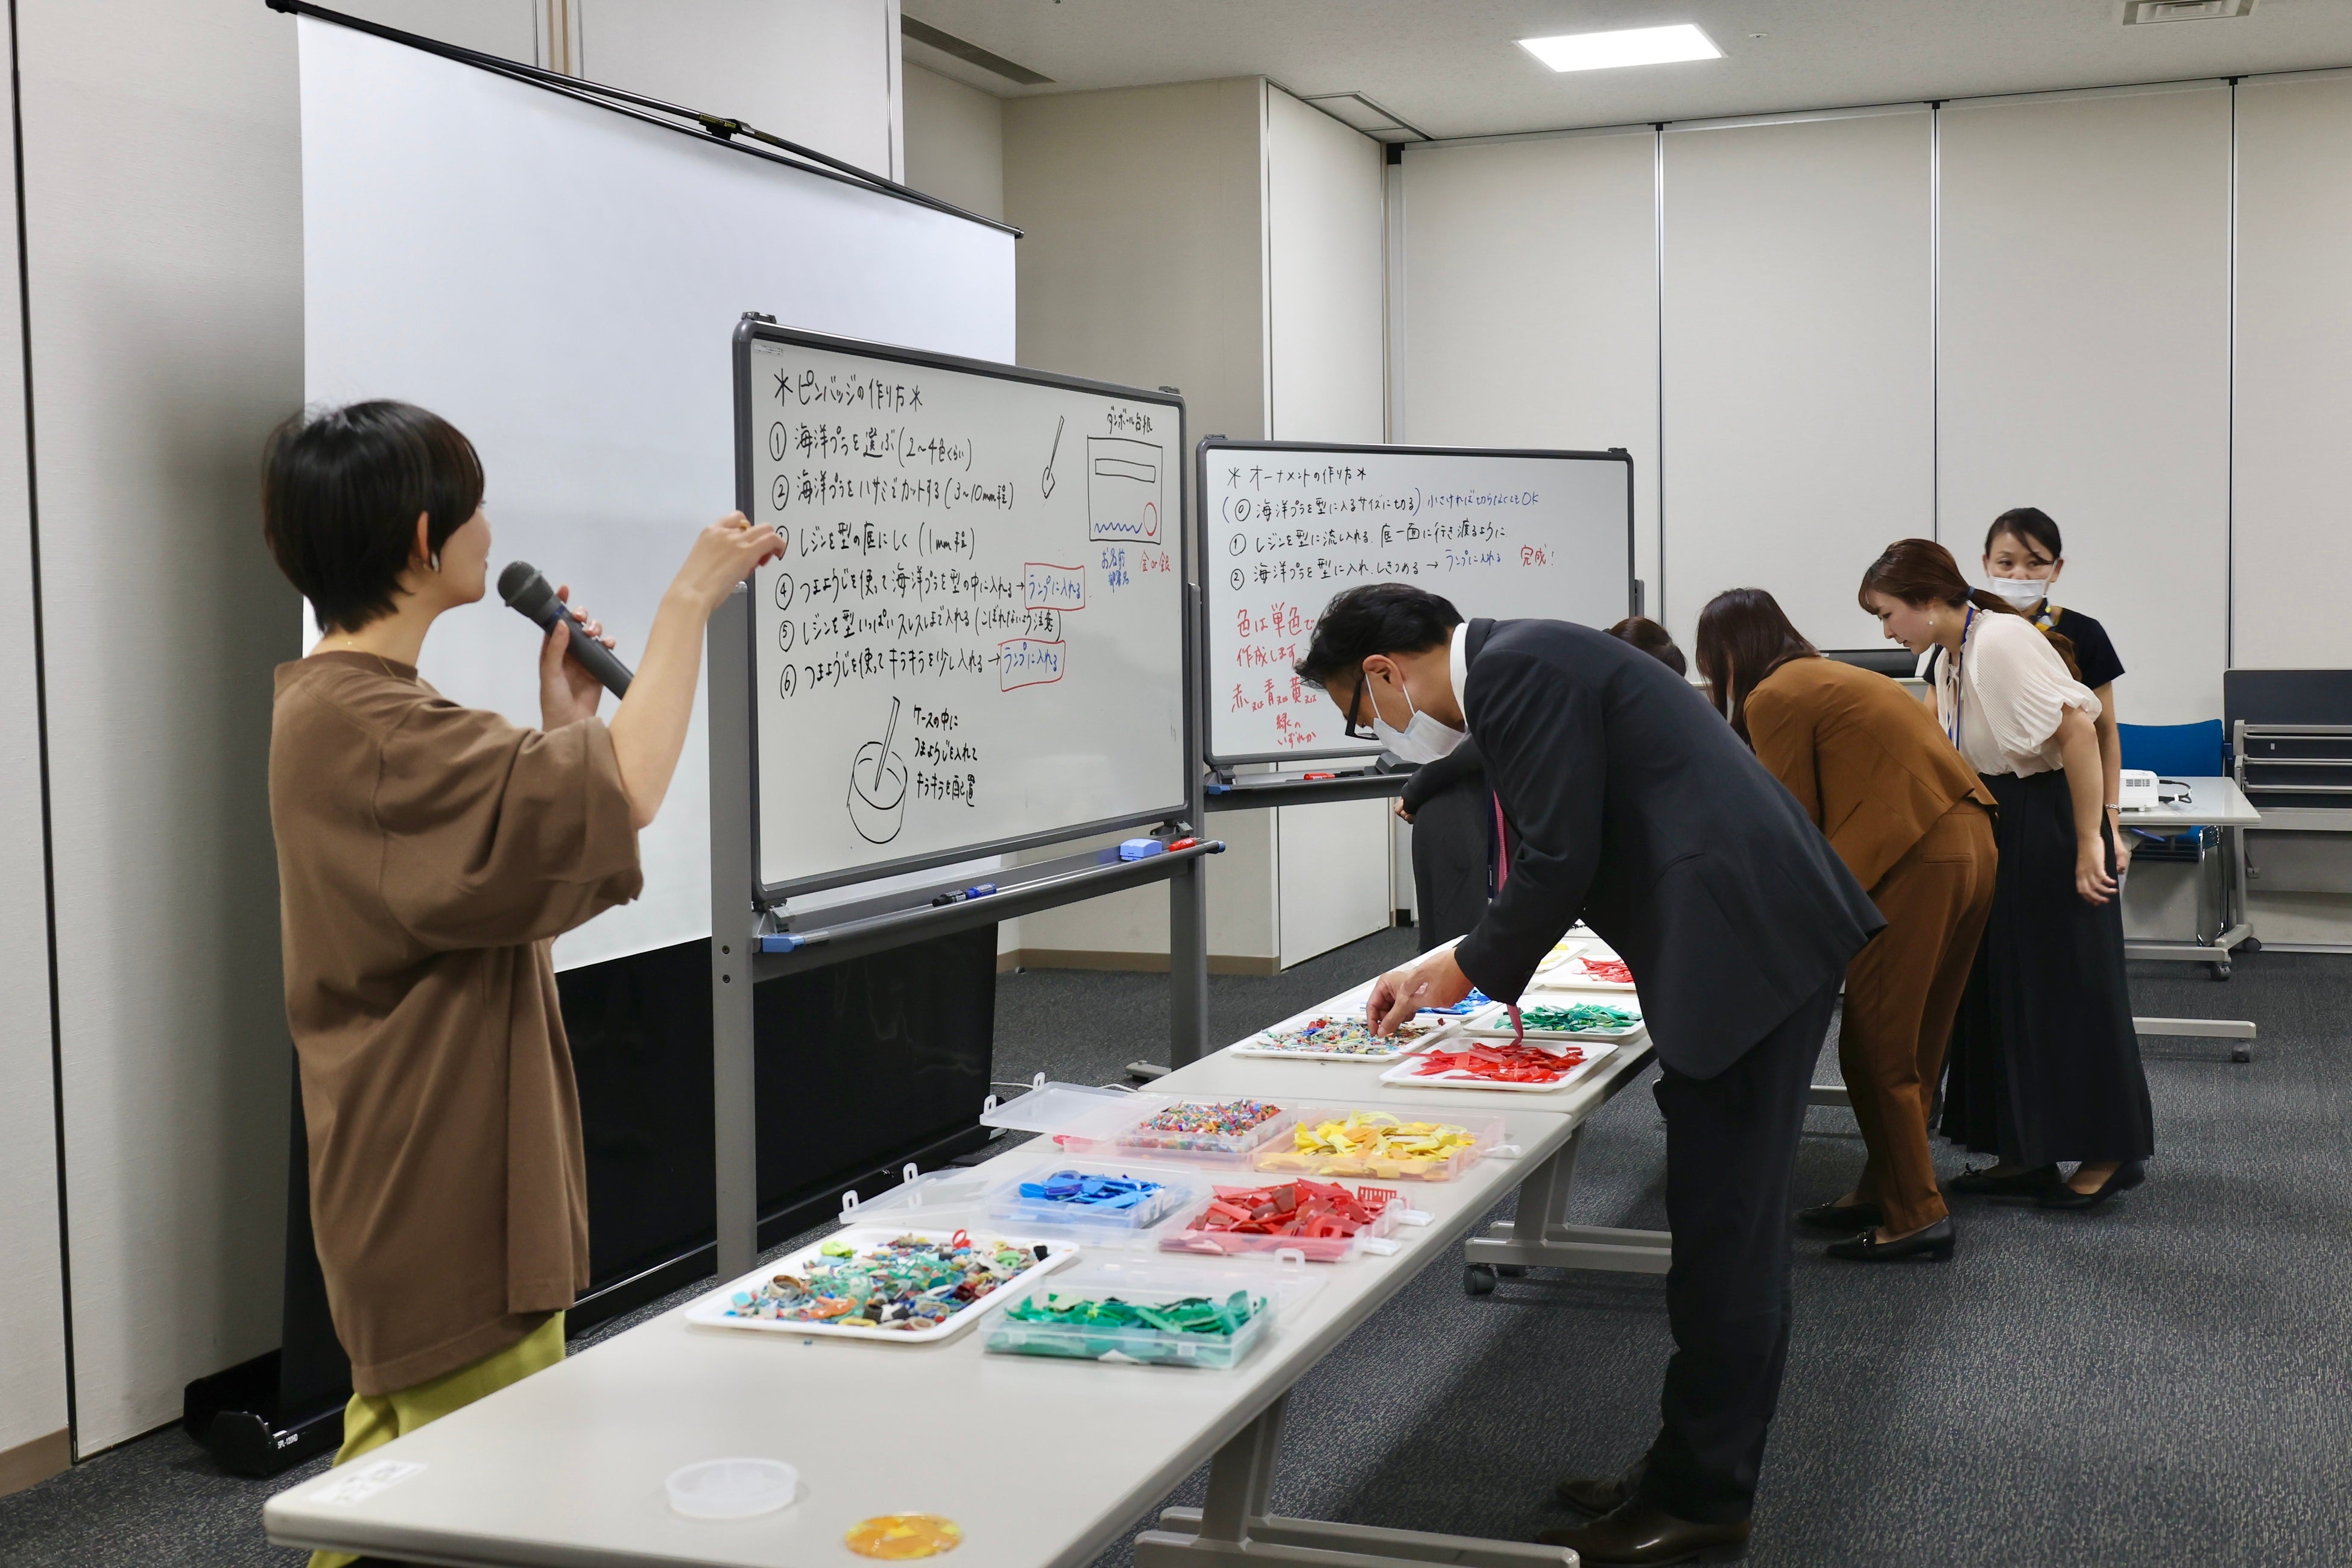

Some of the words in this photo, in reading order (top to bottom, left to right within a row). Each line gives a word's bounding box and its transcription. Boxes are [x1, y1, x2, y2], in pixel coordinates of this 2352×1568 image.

[1107, 406, 1153, 435] ダンボール台紙
[1101, 547, 1125, 570] お名前
[1445, 549, 1501, 572] ランプに入れる
[1028, 574, 1081, 602] ランプに入れる
[1238, 602, 1315, 637] 色は単色で
[1004, 642, 1057, 674] ランプに入れる
[914, 704, 958, 731] ケースの中に
[915, 738, 978, 766] つまようじを入れて
[1277, 731, 1317, 749] いずれか
[917, 771, 975, 807] キラキラを配置
